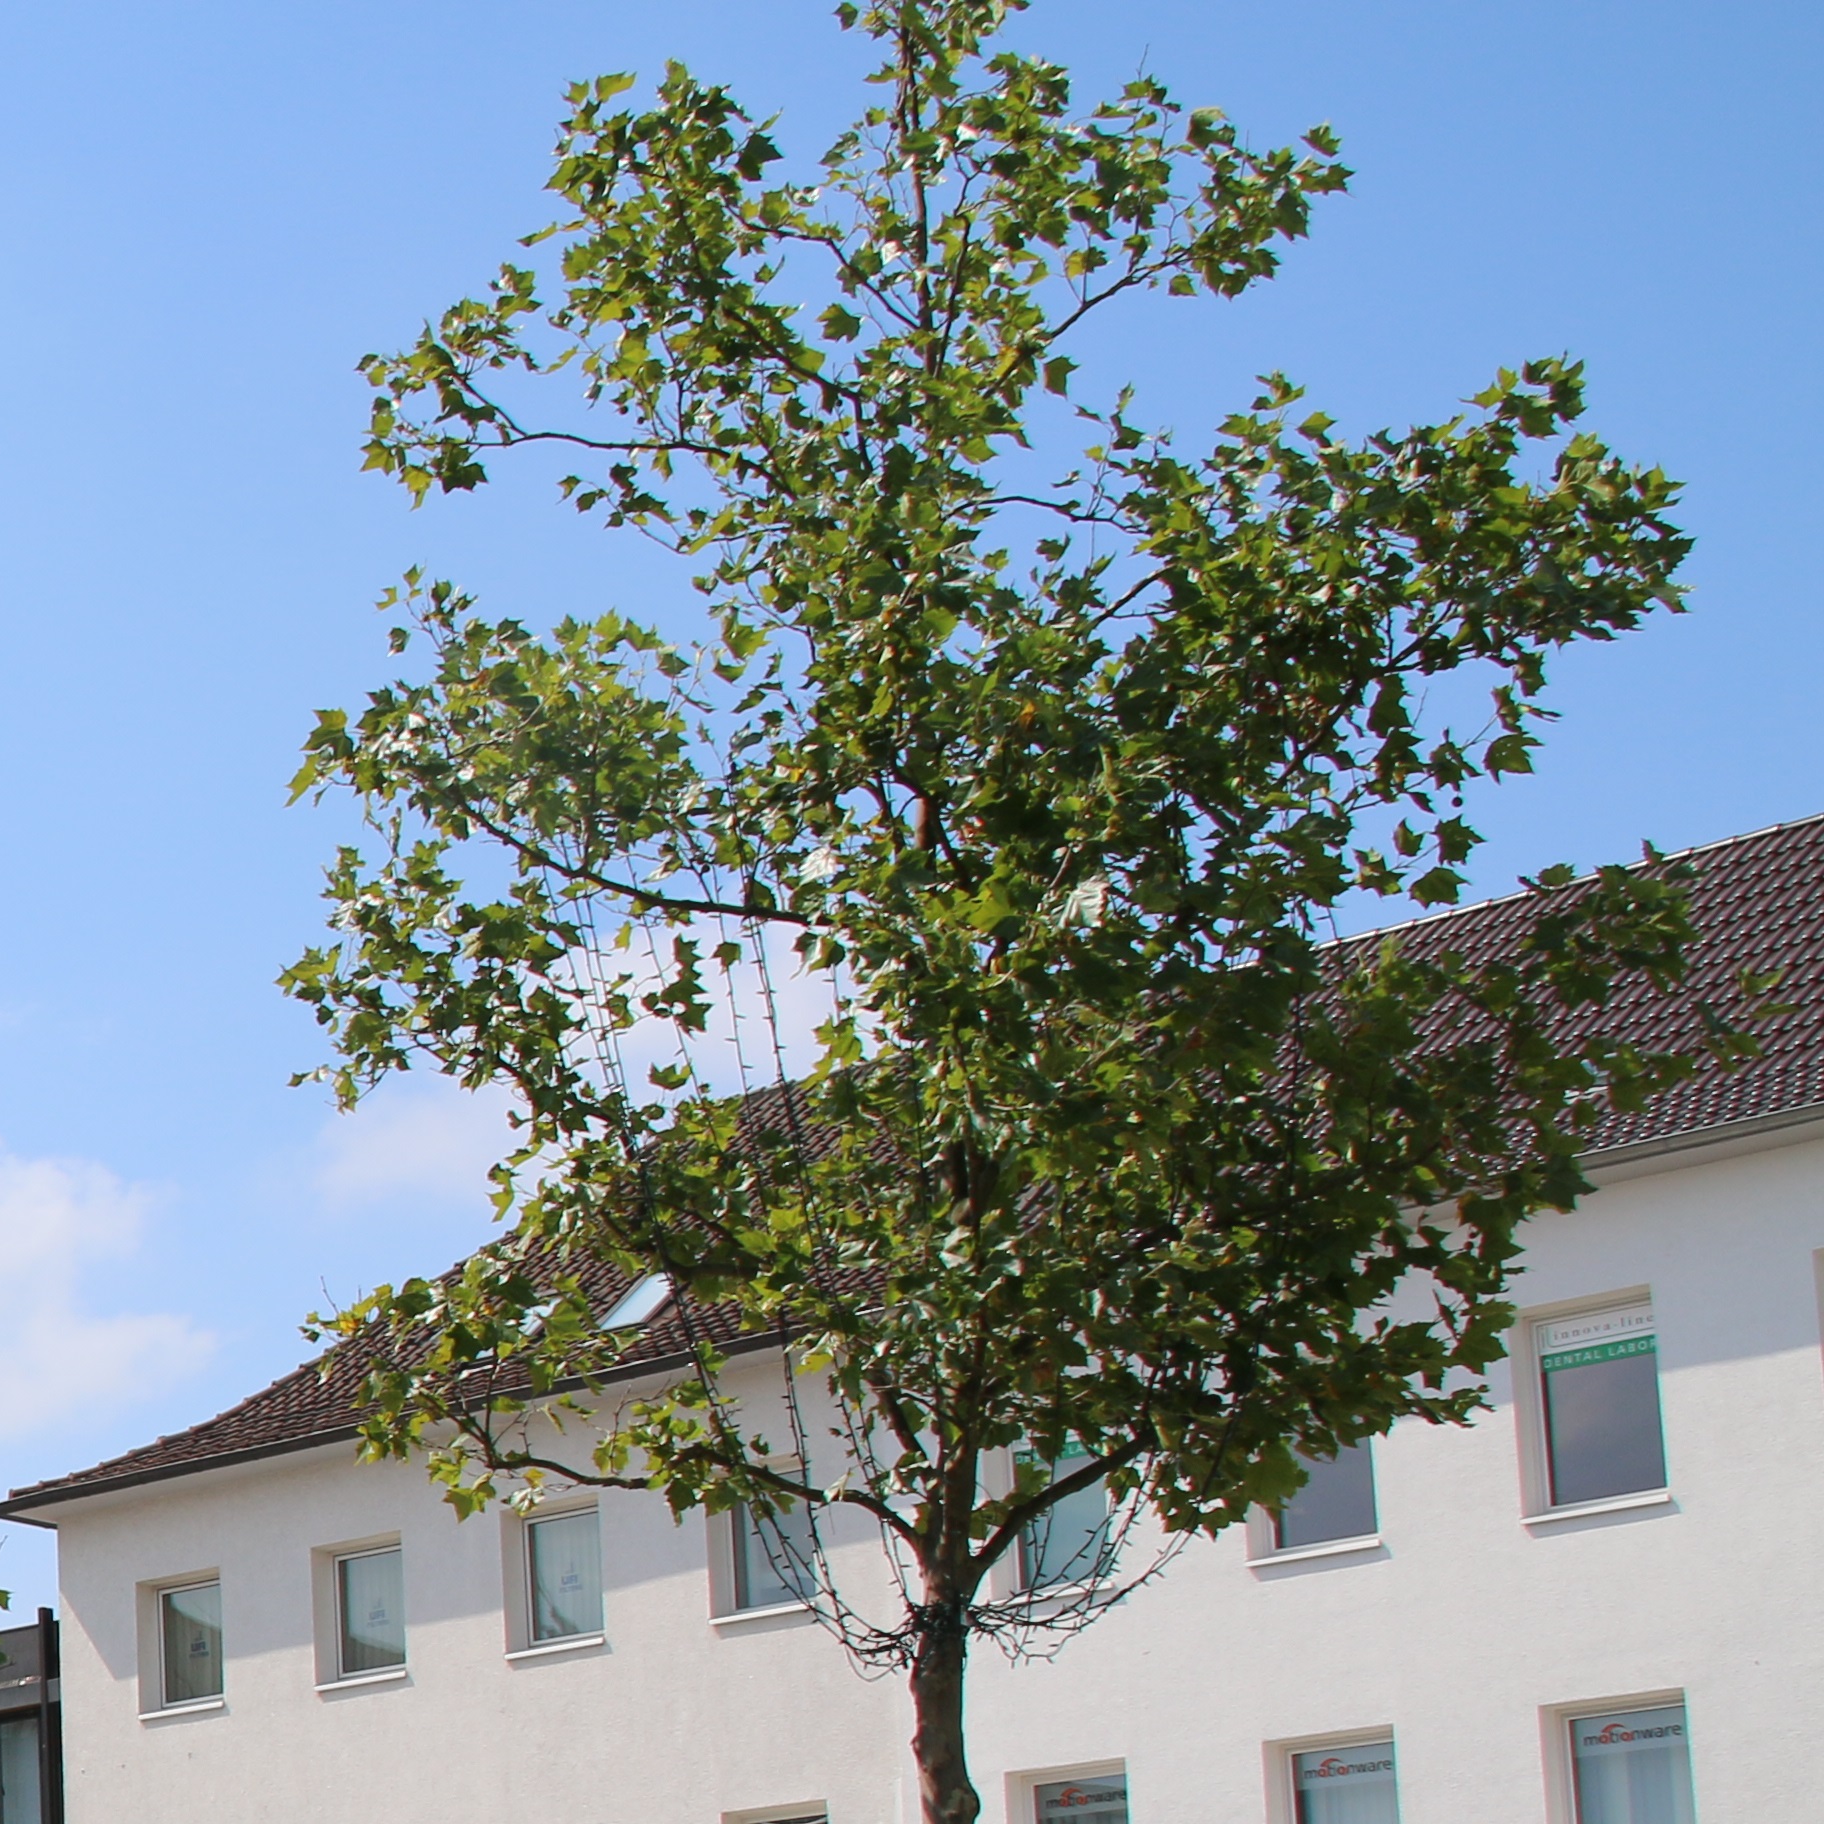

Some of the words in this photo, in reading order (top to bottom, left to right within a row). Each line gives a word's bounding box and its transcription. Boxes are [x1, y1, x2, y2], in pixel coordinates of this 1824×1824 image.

[1543, 1349, 1601, 1369] DENTAL
[1583, 1723, 1682, 1747] motionware
[1304, 1758, 1392, 1779] motionware
